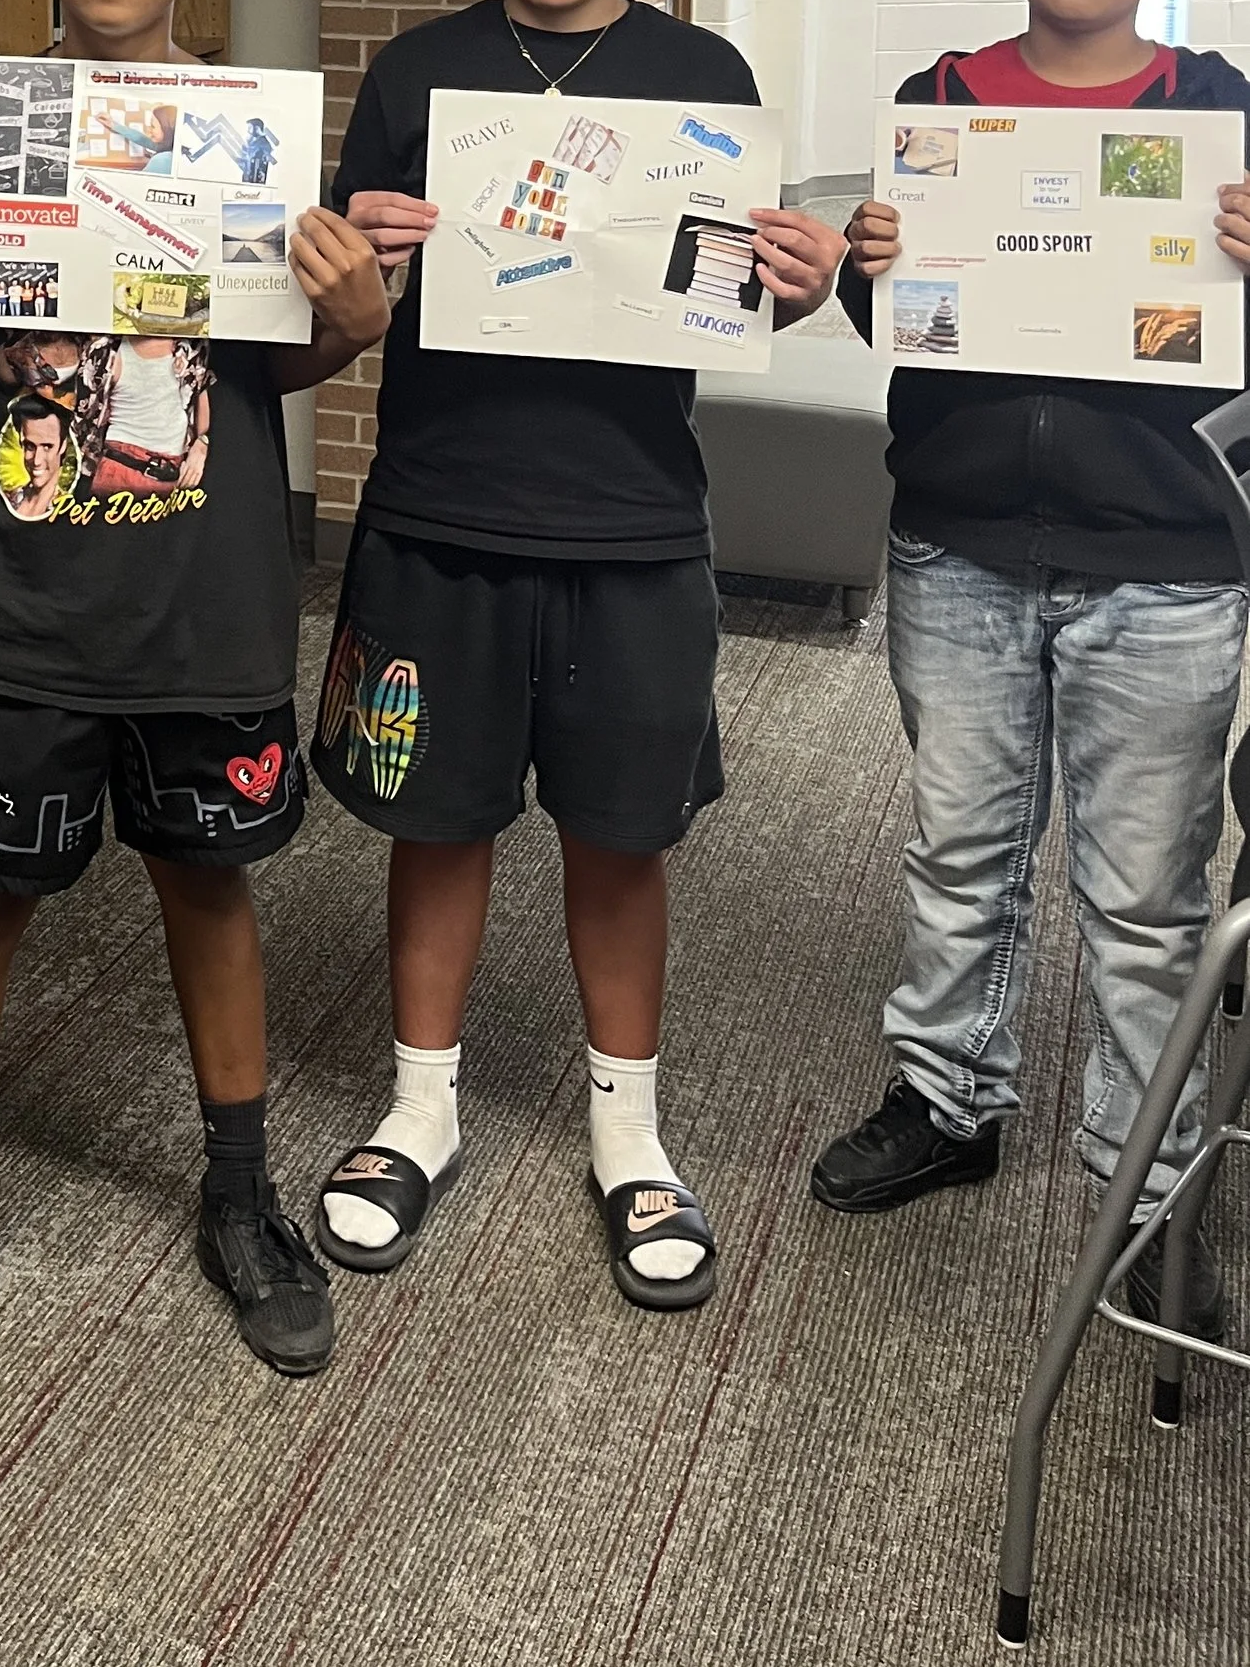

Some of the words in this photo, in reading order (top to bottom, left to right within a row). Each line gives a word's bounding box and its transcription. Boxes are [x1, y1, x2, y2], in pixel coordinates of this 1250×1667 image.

[970, 119, 1016, 131] SUPER
[450, 118, 515, 154] BRAVE
[645, 160, 704, 182] SHARP
[1034, 177, 1069, 185] INVEST
[146, 190, 193, 206] smart
[471, 176, 501, 213] BRIGHT
[690, 192, 724, 207] Genius
[888, 188, 926, 202] Great
[1033, 196, 1069, 204] HEALTH
[82, 176, 113, 205] Time
[115, 200, 199, 259] Management
[996, 235, 1039, 252] GOOD
[1042, 235, 1092, 253] SPORT
[1154, 239, 1190, 262] silly
[115, 252, 164, 272] CALM
[216, 273, 289, 292] Unexpected
[48, 493, 100, 526] Pet
[104, 486, 208, 526] Detective
[346, 1152, 394, 1173] NIKE
[634, 1190, 680, 1214] NIKE
